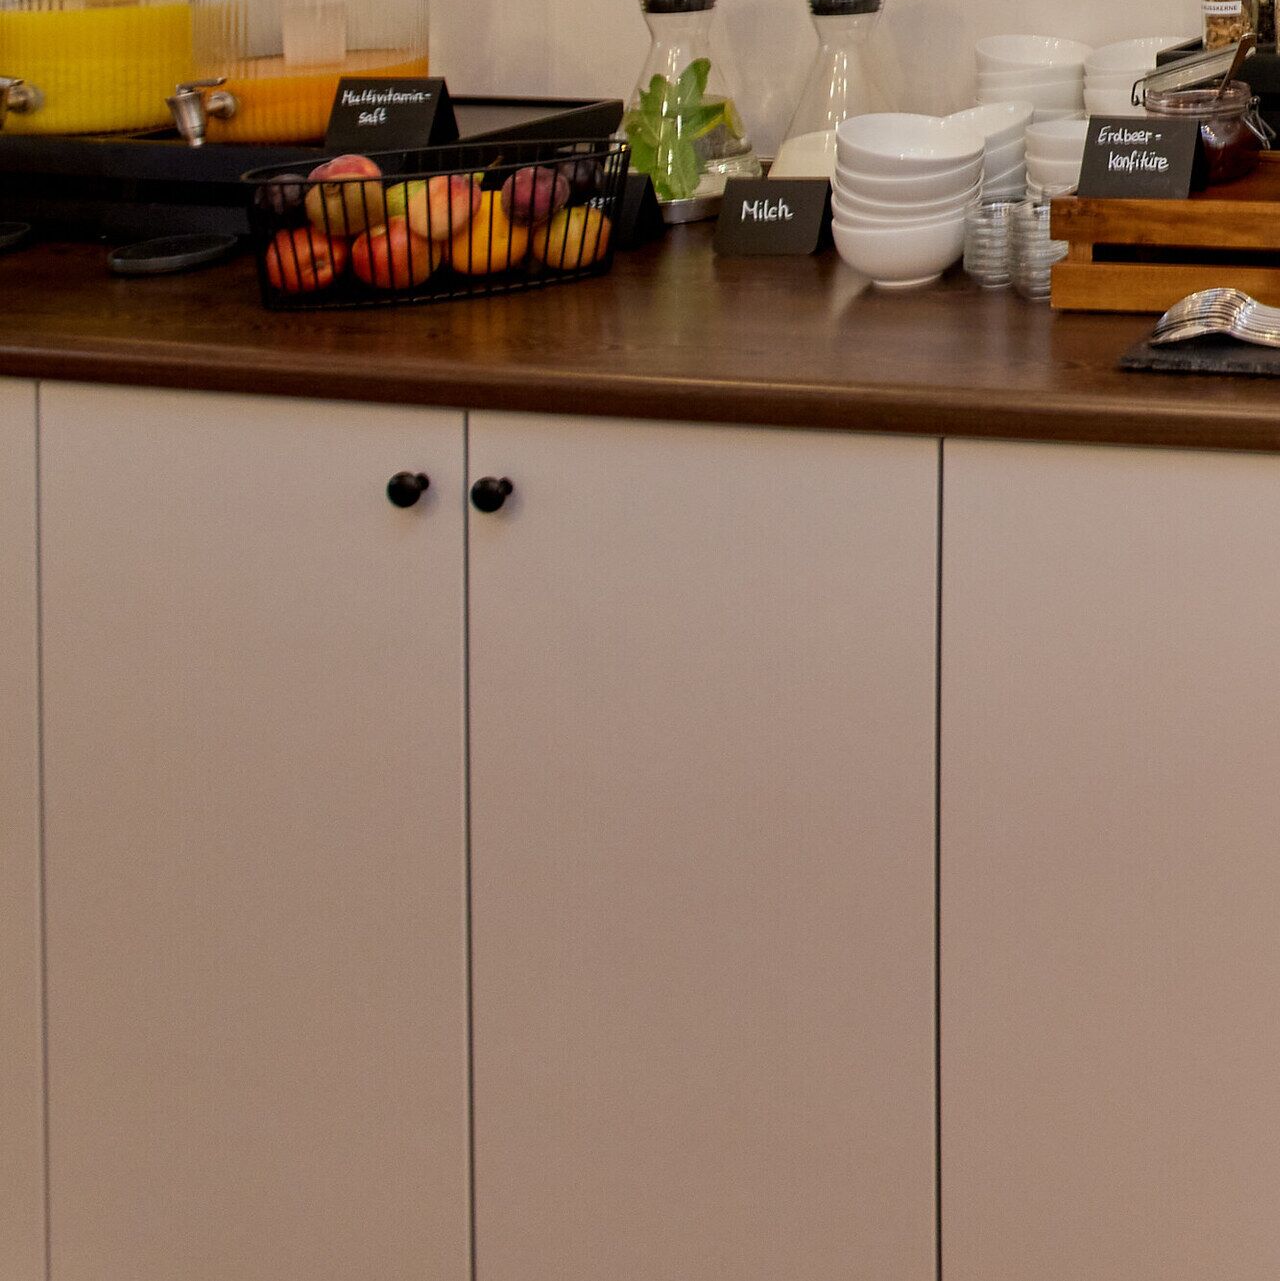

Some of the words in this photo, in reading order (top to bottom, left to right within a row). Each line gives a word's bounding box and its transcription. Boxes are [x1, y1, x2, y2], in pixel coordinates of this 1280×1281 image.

[340, 86, 434, 106] Multivitamin-
[357, 105, 388, 125] saft
[1097, 124, 1163, 144] Erdbeer-
[1107, 150, 1170, 173] konfitüre
[741, 199, 796, 222] Milch
